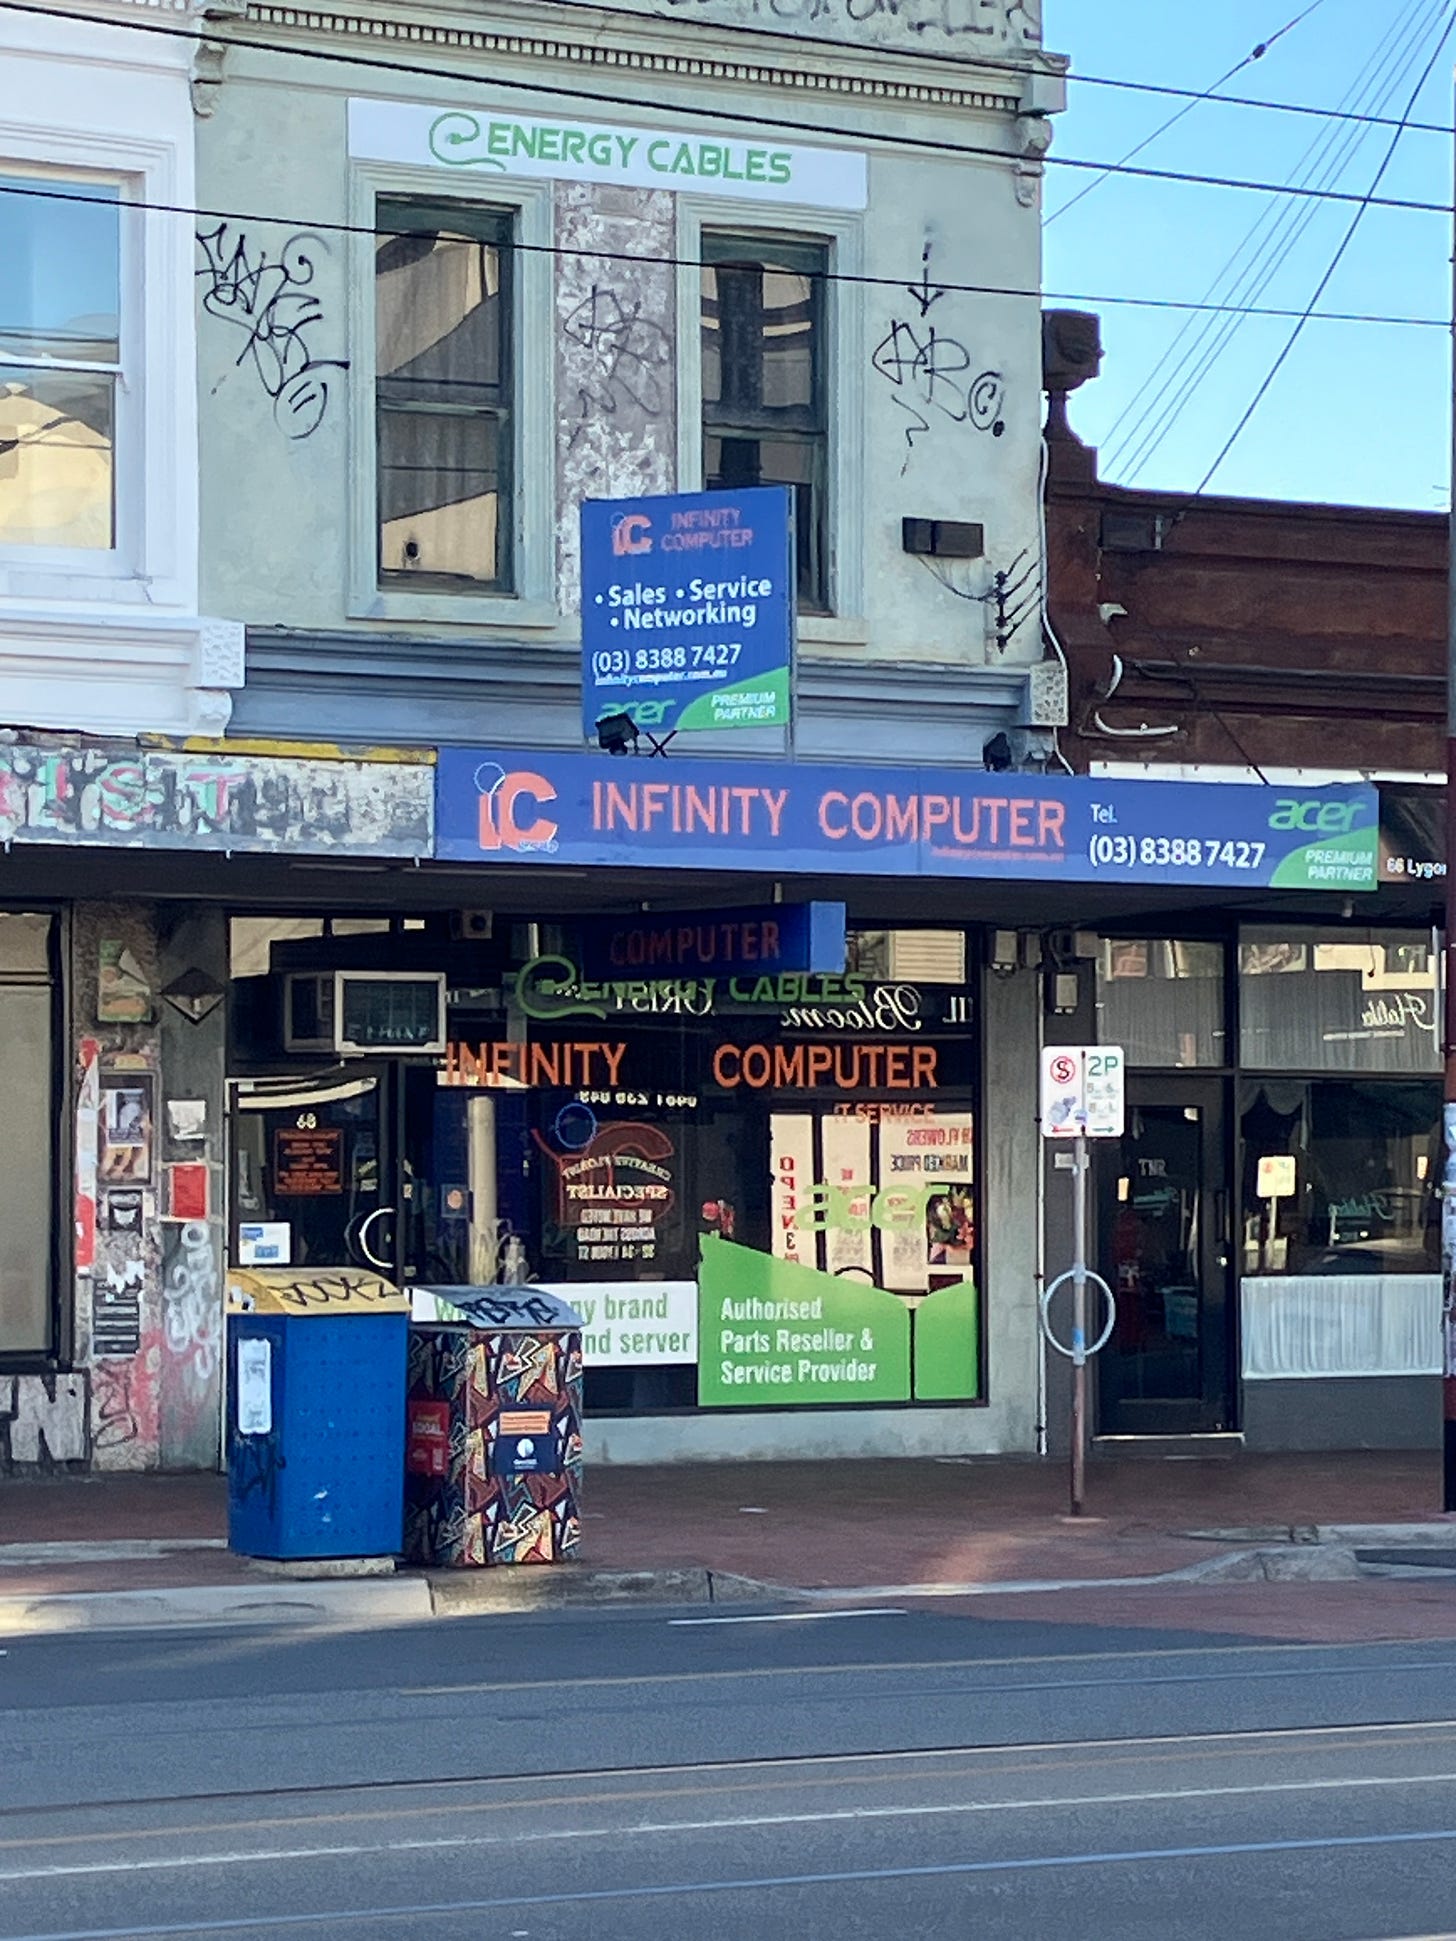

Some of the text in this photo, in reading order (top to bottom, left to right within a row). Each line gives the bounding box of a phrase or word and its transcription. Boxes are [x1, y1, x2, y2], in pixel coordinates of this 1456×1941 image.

[487, 122, 792, 184] ENERGY CABLES
[671, 508, 741, 529] INFINITY
[661, 529, 753, 550] COMPUTER
[608, 576, 772, 606] Sales Service
[624, 601, 756, 629] Networking
[592, 644, 742, 673] (03) 8388 7427
[711, 691, 775, 707] PREMIUM
[714, 706, 776, 720] PARTNER
[592, 781, 790, 836] INFINITY
[818, 790, 1066, 847] COMPUTER
[1090, 804, 1118, 824] Tel.
[1268, 799, 1367, 831] acer
[1089, 834, 1136, 868] (03)
[1139, 838, 1202, 866] 8388
[1205, 841, 1266, 868] 7427
[1304, 851, 1373, 866] PREMIUM
[1308, 866, 1374, 881] PARTNER
[610, 921, 781, 965] COMPUTER
[444, 1043, 937, 1088] INFINITY COMPUTER
[1088, 1056, 1118, 1076] 2P
[605, 1293, 668, 1320] brand
[721, 1297, 823, 1321] Authorised
[620, 1331, 690, 1354] server
[721, 1326, 873, 1354] Parts Reseller &
[721, 1358, 877, 1385] Service Provider
